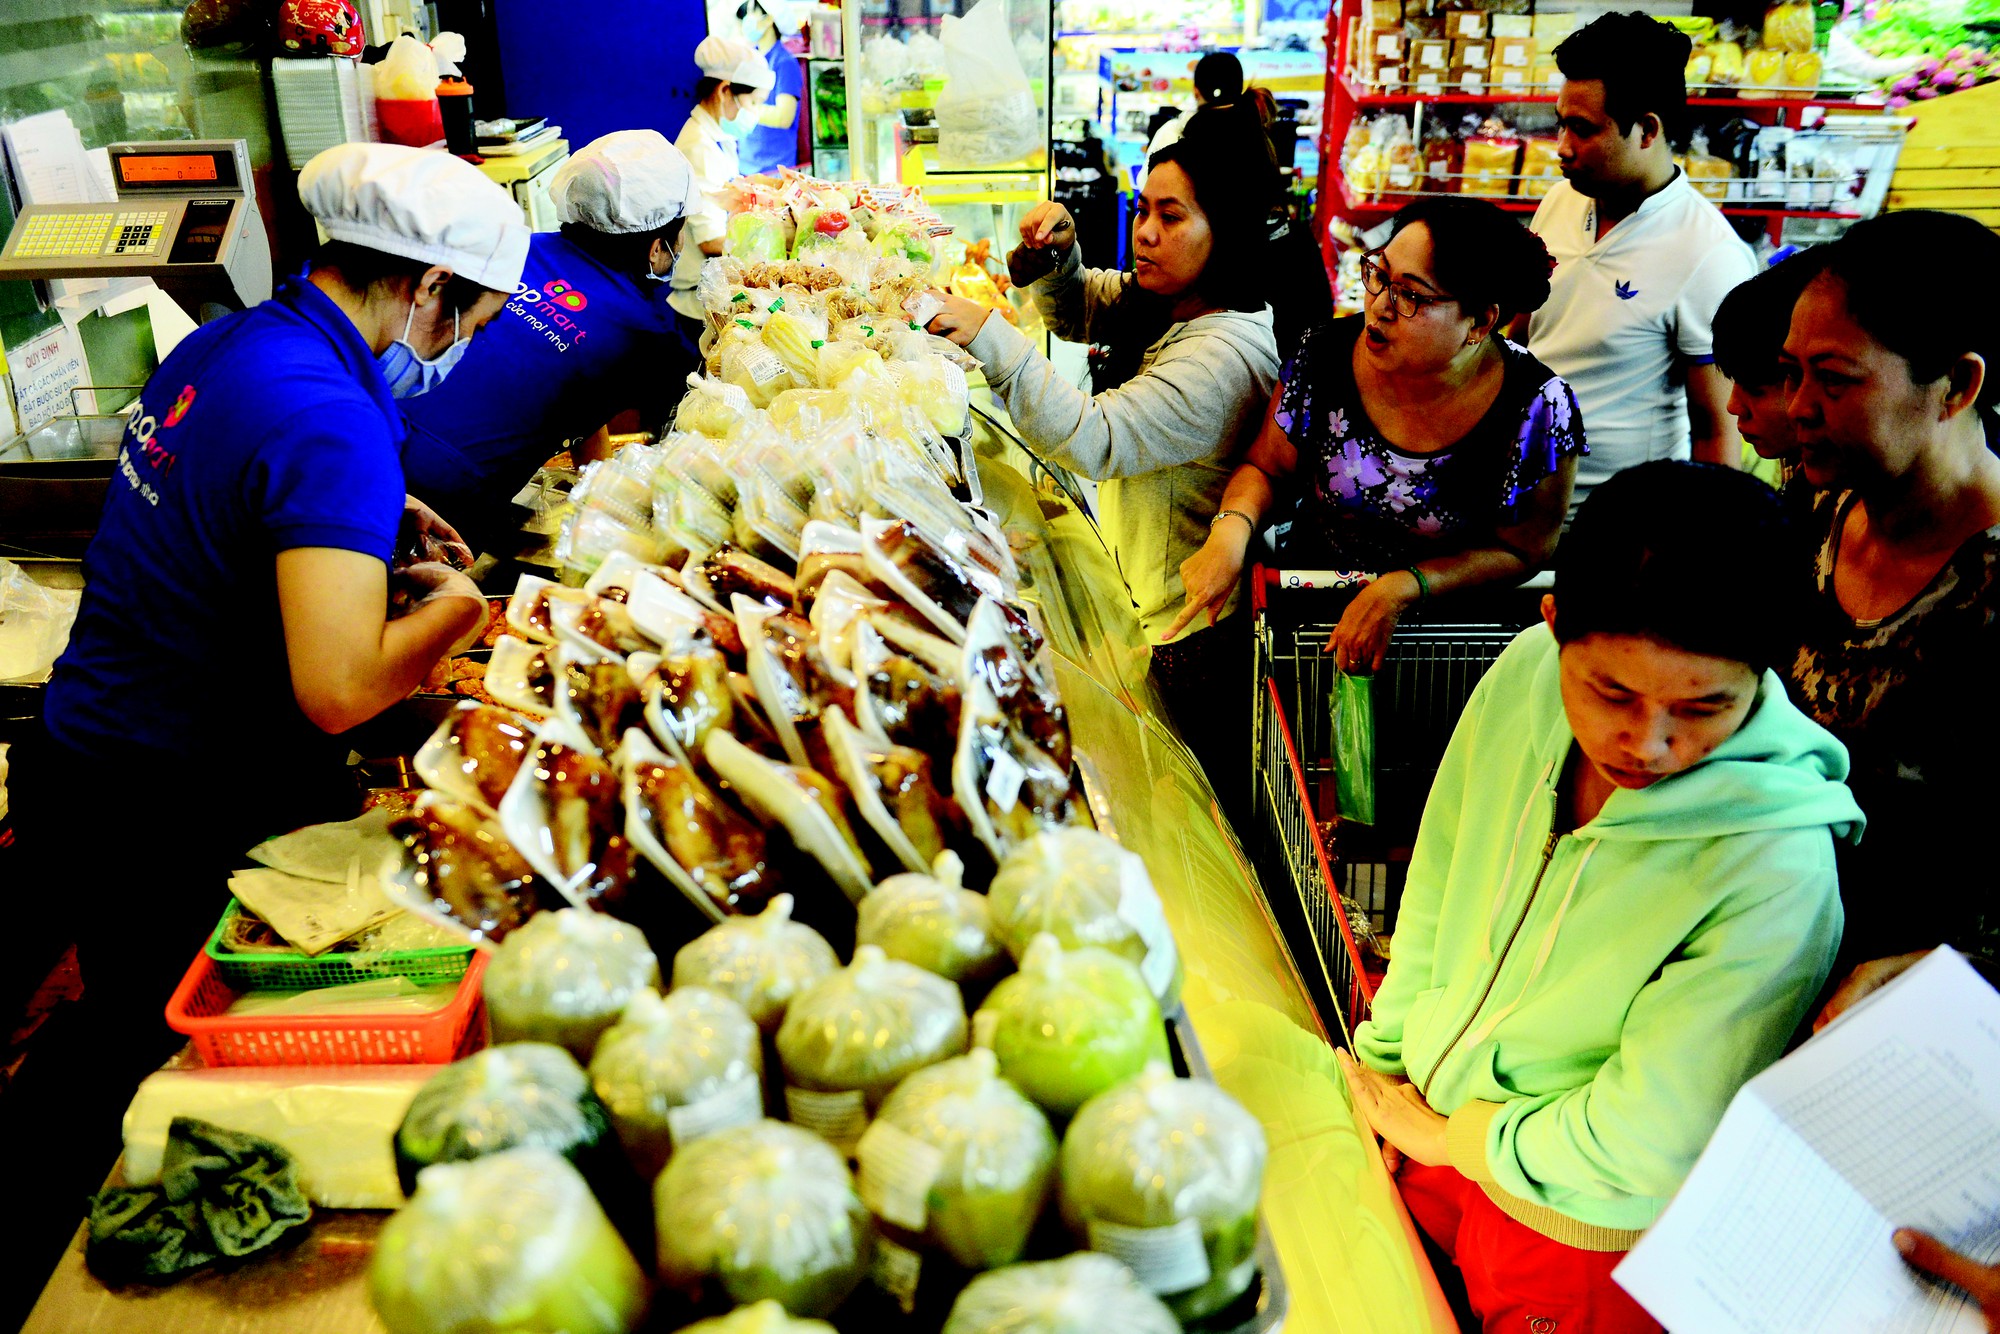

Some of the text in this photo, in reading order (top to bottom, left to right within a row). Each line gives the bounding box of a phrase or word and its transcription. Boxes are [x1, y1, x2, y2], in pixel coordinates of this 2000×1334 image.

[505, 301, 570, 353] của mọi nhà
[25, 342, 59, 369] QUY ĐỊNH
